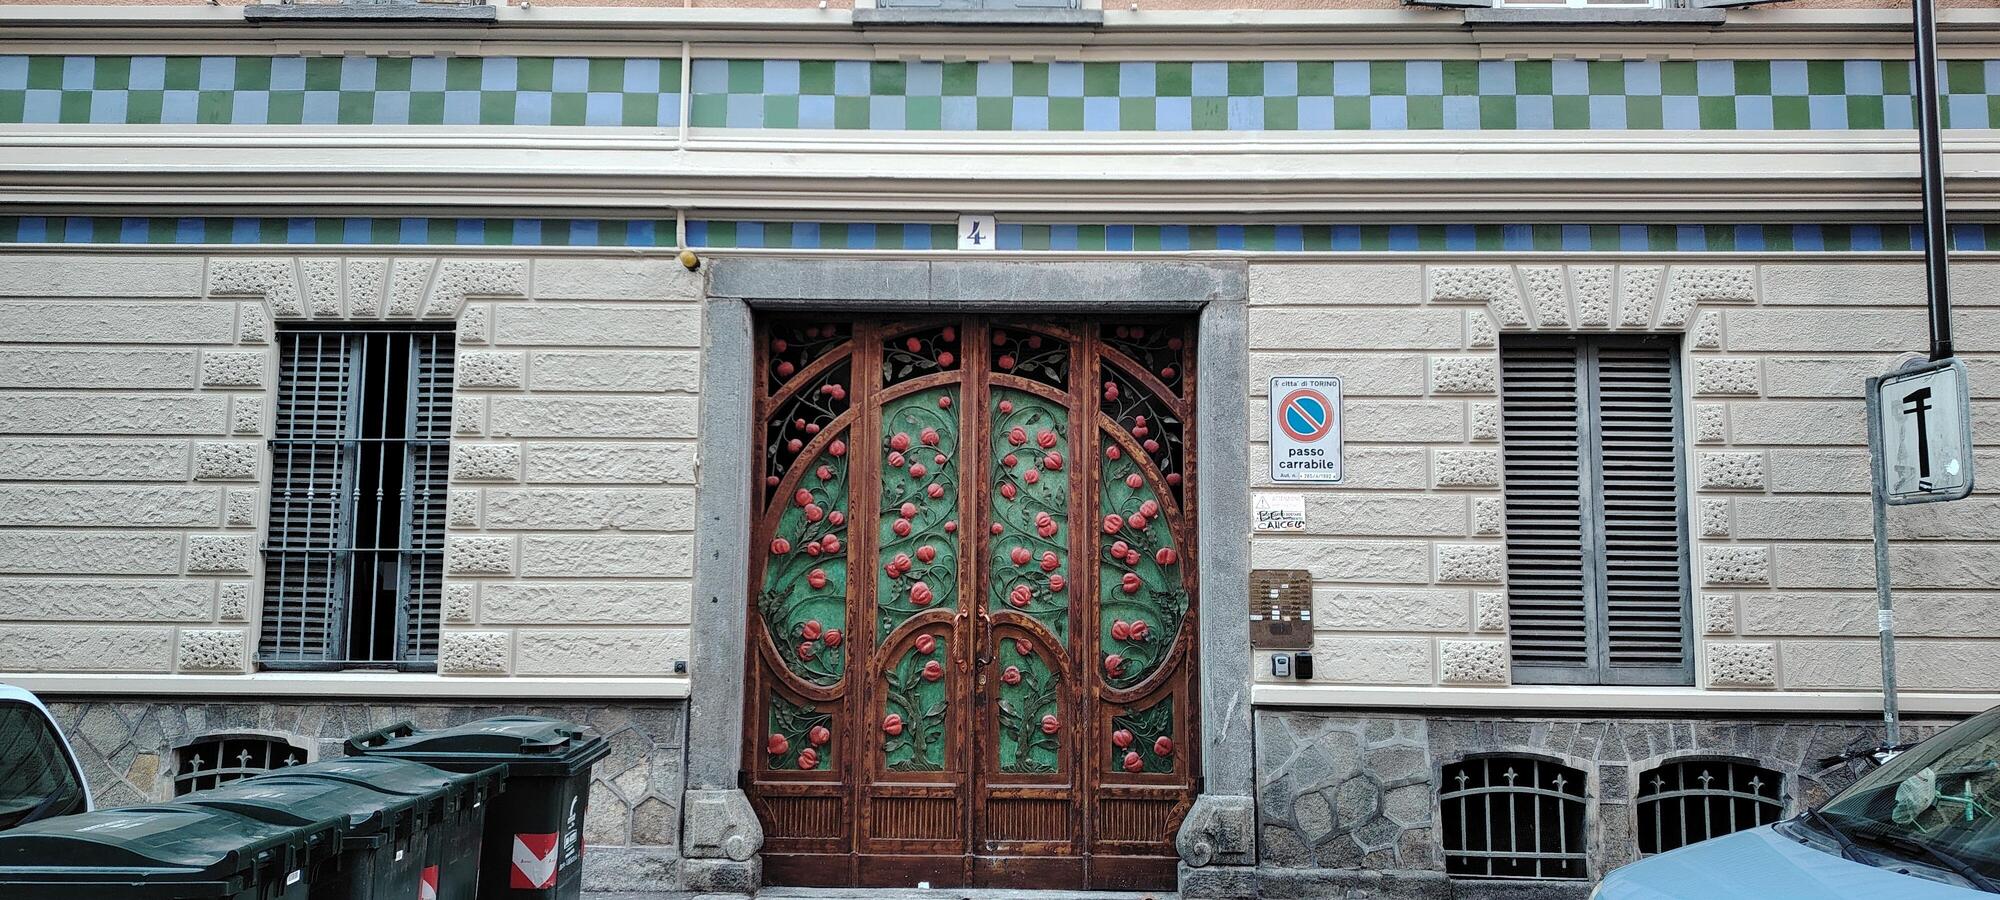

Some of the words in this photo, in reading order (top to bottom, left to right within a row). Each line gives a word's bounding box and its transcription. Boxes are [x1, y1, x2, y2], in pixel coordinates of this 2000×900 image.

[967, 221, 986, 245] 4
[1288, 448, 1324, 458] passo
[1279, 459, 1334, 469] carrabile
